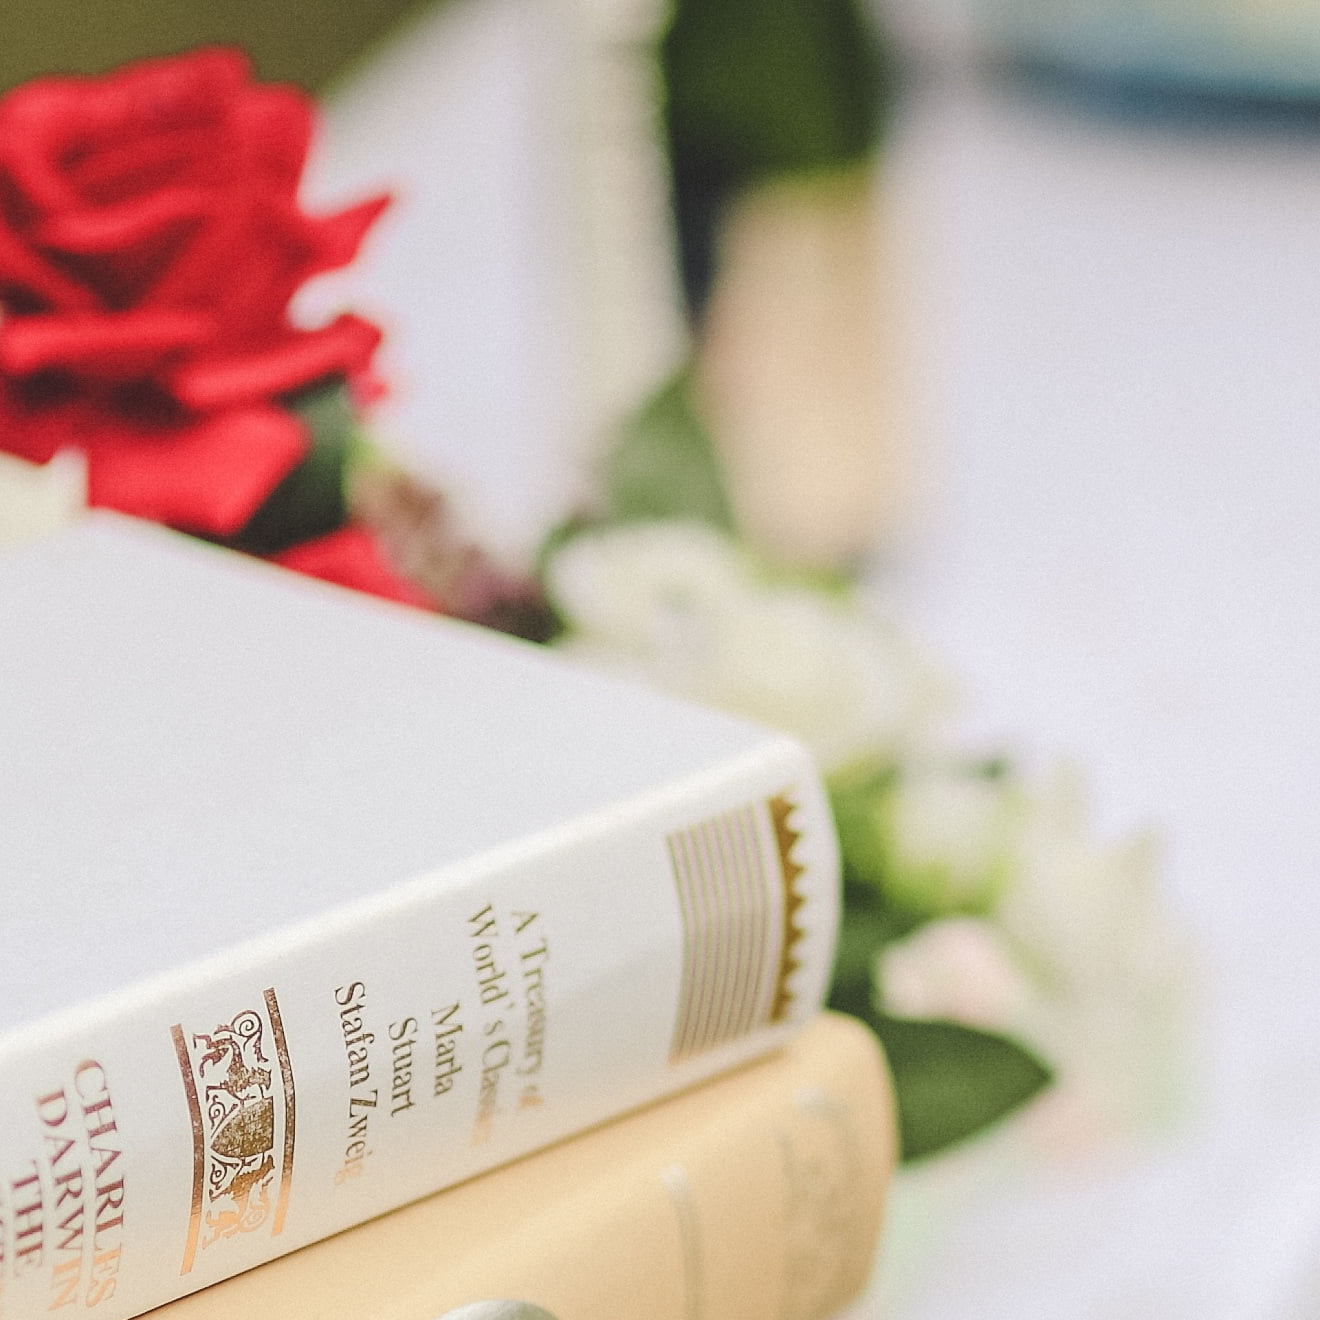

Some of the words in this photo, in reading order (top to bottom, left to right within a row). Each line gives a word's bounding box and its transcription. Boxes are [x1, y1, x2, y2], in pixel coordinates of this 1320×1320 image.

[333, 981, 375, 1088] Stafan
[388, 1017, 418, 1118] Stuart
[430, 1000, 463, 1097] Marla
[13, 1159, 43, 1277] THE
[36, 1088, 85, 1312] DARWIN
[74, 1059, 125, 1308] CHARLES
